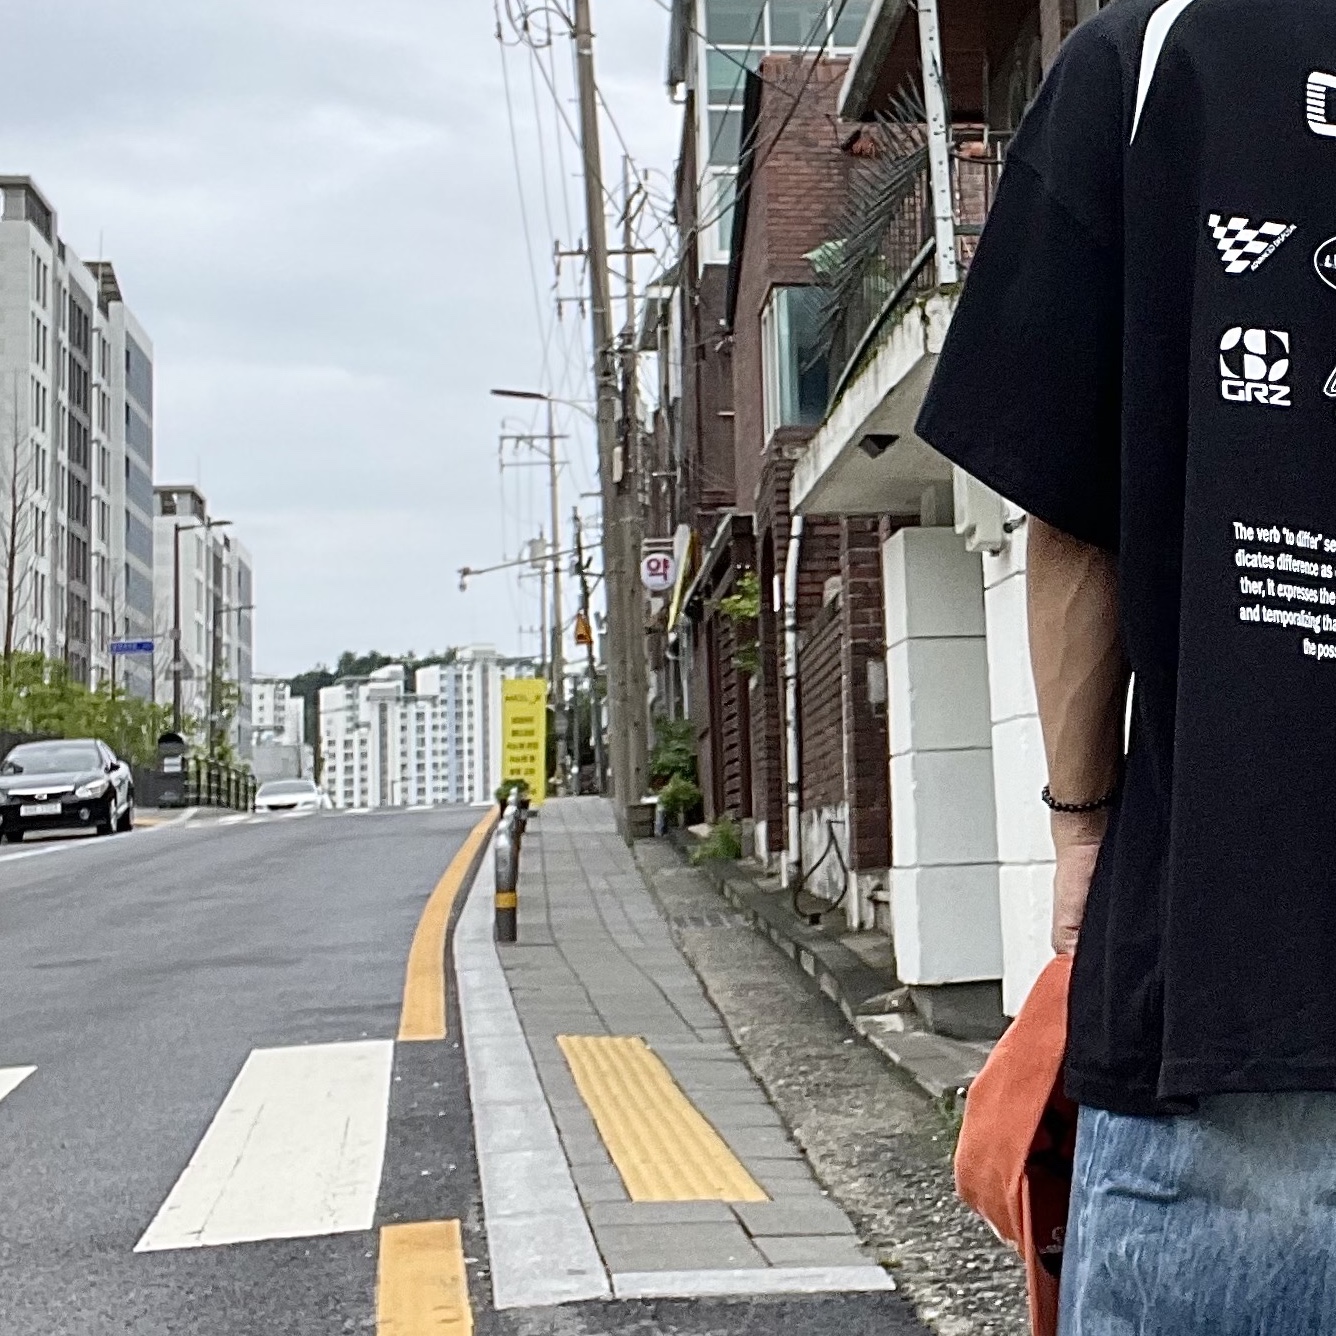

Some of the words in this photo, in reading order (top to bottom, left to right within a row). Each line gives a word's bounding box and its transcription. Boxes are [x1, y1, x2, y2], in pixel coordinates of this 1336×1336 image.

[1221, 379, 1291, 406] GRZ
[1233, 522, 1254, 540] The
[1256, 525, 1281, 544] verb
[647, 558, 670, 581] 약
[1235, 549, 1275, 569] dicates
[1277, 553, 1319, 577] difference
[1320, 564, 1333, 579] as
[1240, 576, 1266, 598] ther,
[1266, 578, 1276, 596] it
[1277, 582, 1318, 602] expresses
[1319, 587, 1336, 605] the
[1239, 604, 1260, 622] and
